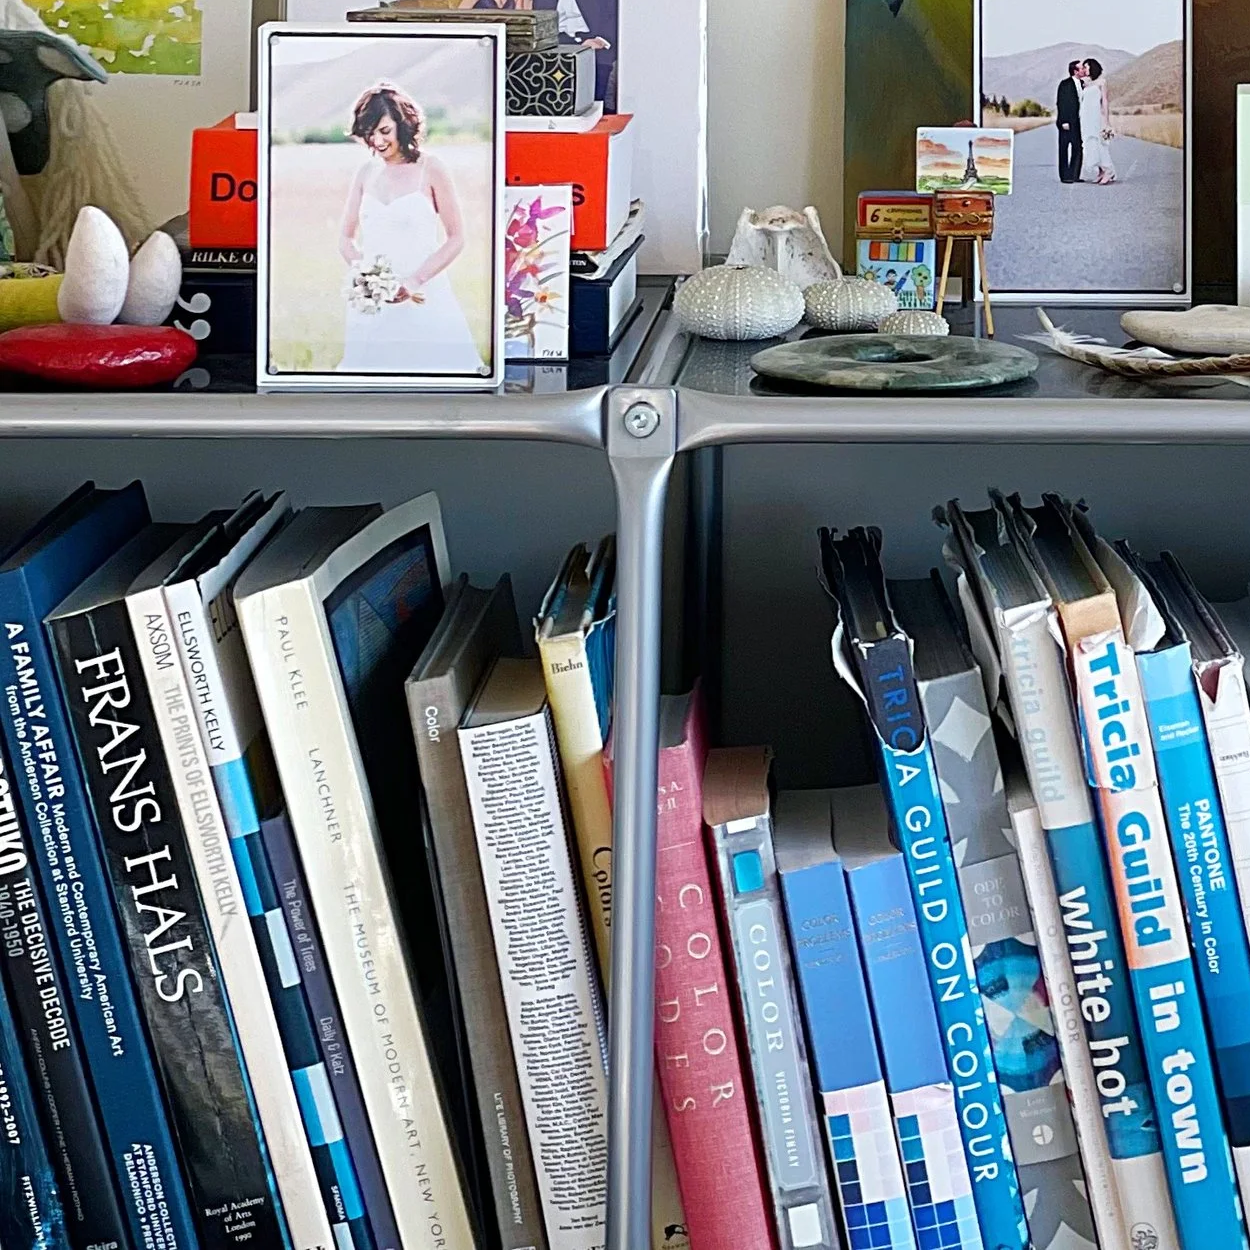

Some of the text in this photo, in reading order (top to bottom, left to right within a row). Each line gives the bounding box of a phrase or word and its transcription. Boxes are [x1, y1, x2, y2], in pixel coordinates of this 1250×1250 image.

[192, 252, 237, 263] RILKE
[143, 613, 174, 671] AXSOM
[277, 615, 292, 662] PAUL
[551, 659, 584, 675] Biehn
[177, 610, 225, 751] ELLSWORTH KELLY
[290, 669, 308, 711] KLEE
[425, 705, 441, 743] Color
[1012, 636, 1040, 715] tricia
[1030, 727, 1066, 804] guild
[75, 646, 203, 1002] FRANS HALS
[164, 684, 238, 916] THE PRINTS OF ELLSWORTH KELLY
[309, 747, 342, 844] LANCHNER
[1178, 802, 1192, 829] The
[5, 623, 124, 1056] A FAMILY AFFAIR Modern and Contemporary American Art
[5, 685, 93, 1000] from the Anderson Collection at Stanford University
[905, 805, 948, 922] GUILD
[1183, 831, 1199, 862] 20th
[1194, 798, 1226, 891] PANTONE
[14, 878, 36, 912] THE
[283, 878, 317, 973] The Power of Trees
[1090, 642, 1209, 1184] Tricia Guild in town
[1189, 865, 1209, 921] Century
[21, 912, 55, 987] DECISIVE
[354, 924, 380, 995] MUSEUM
[931, 943, 964, 1002] ON
[1204, 937, 1219, 974] Color
[39, 986, 71, 1051] DECADE
[374, 1004, 389, 1025] OF
[678, 883, 734, 1108] COLOR
[1059, 886, 1111, 1024] white
[1089, 1036, 1139, 1119] hot
[320, 1016, 336, 1043] Daily
[330, 1055, 344, 1076] Katz
[381, 1034, 409, 1108] MODERN
[749, 923, 800, 1168] COLOR VICTORIA FINLAY
[947, 1022, 999, 1183] COLOUR
[331, 1185, 346, 1221] SFMOMA
[416, 1164, 435, 1203] NEW
